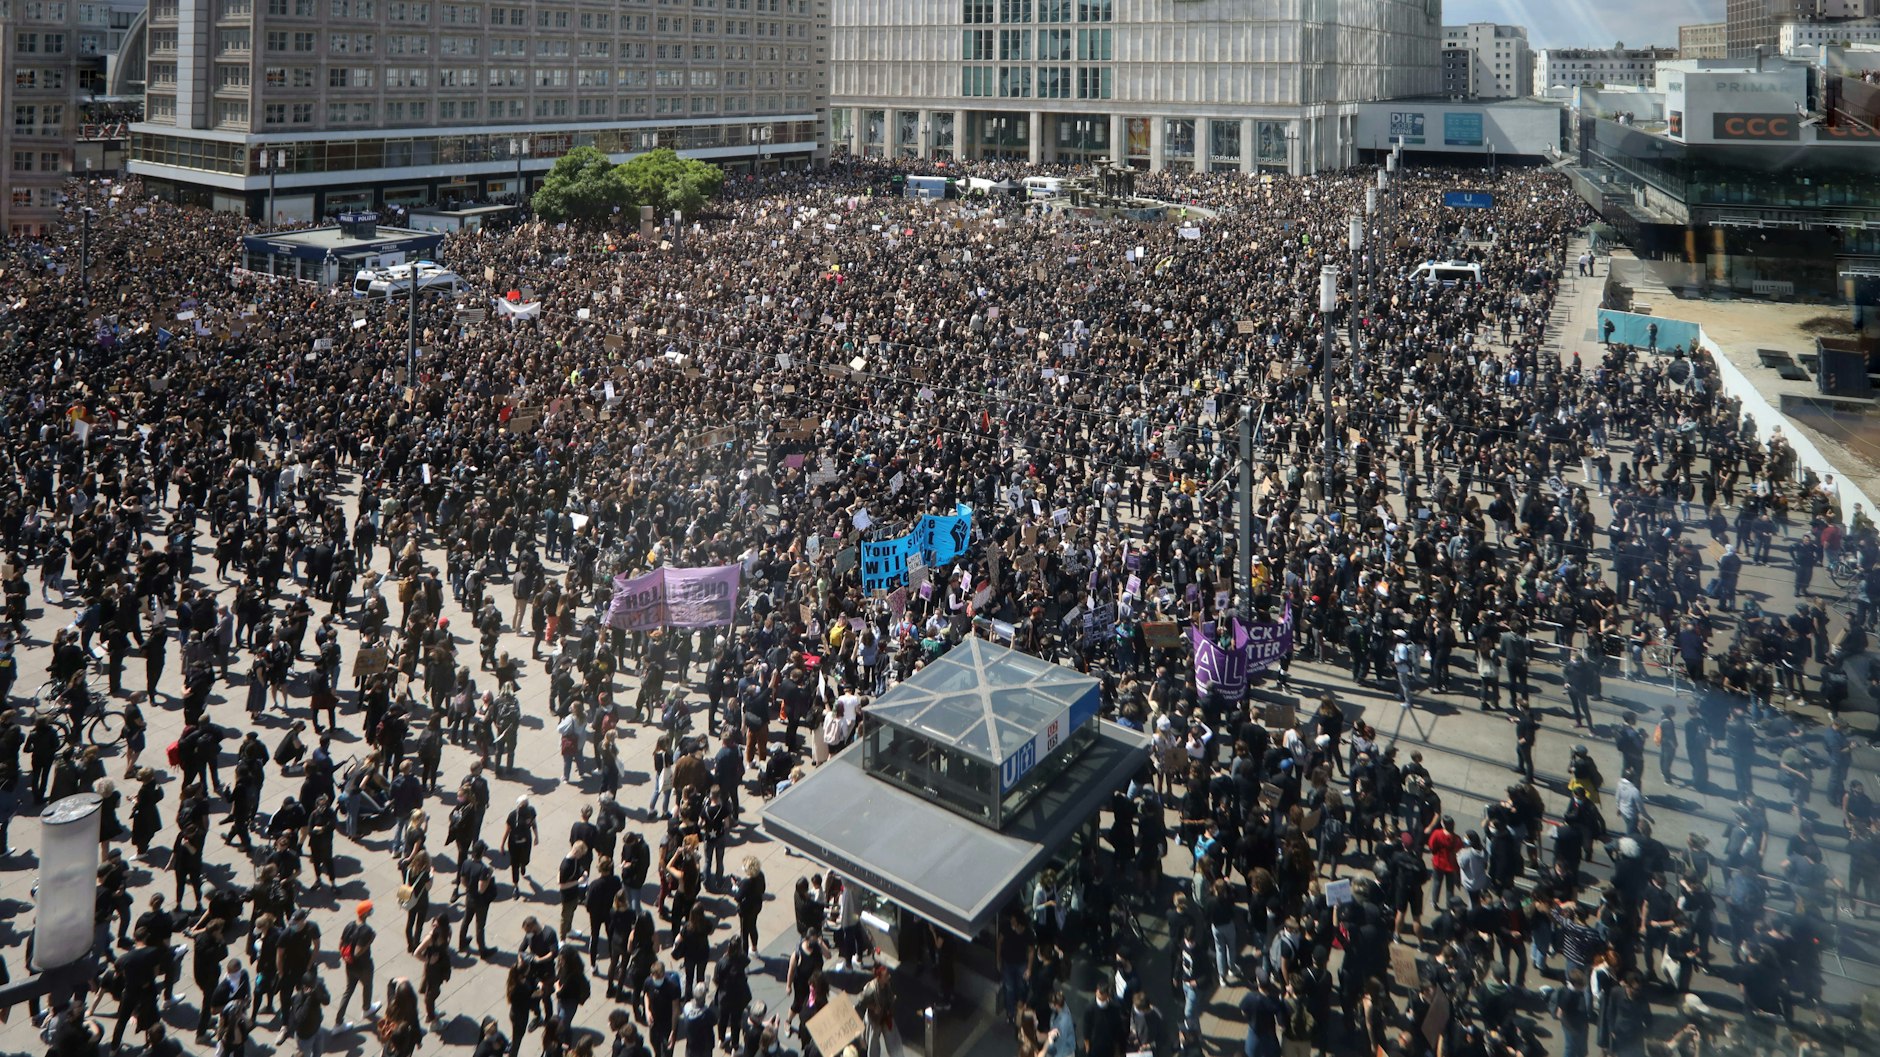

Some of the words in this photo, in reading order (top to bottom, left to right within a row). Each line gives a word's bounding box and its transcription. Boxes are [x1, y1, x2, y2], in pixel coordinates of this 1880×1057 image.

[1715, 81, 1791, 93] PRIMAR
[1392, 113, 1413, 123] DIE
[1724, 117, 1789, 136] CCC
[1464, 193, 1473, 202] U
[357, 214, 377, 222] POLIZEI
[864, 544, 897, 557] Your
[865, 552, 909, 574] will
[1245, 641, 1281, 660] TTER
[1003, 753, 1017, 789] U
